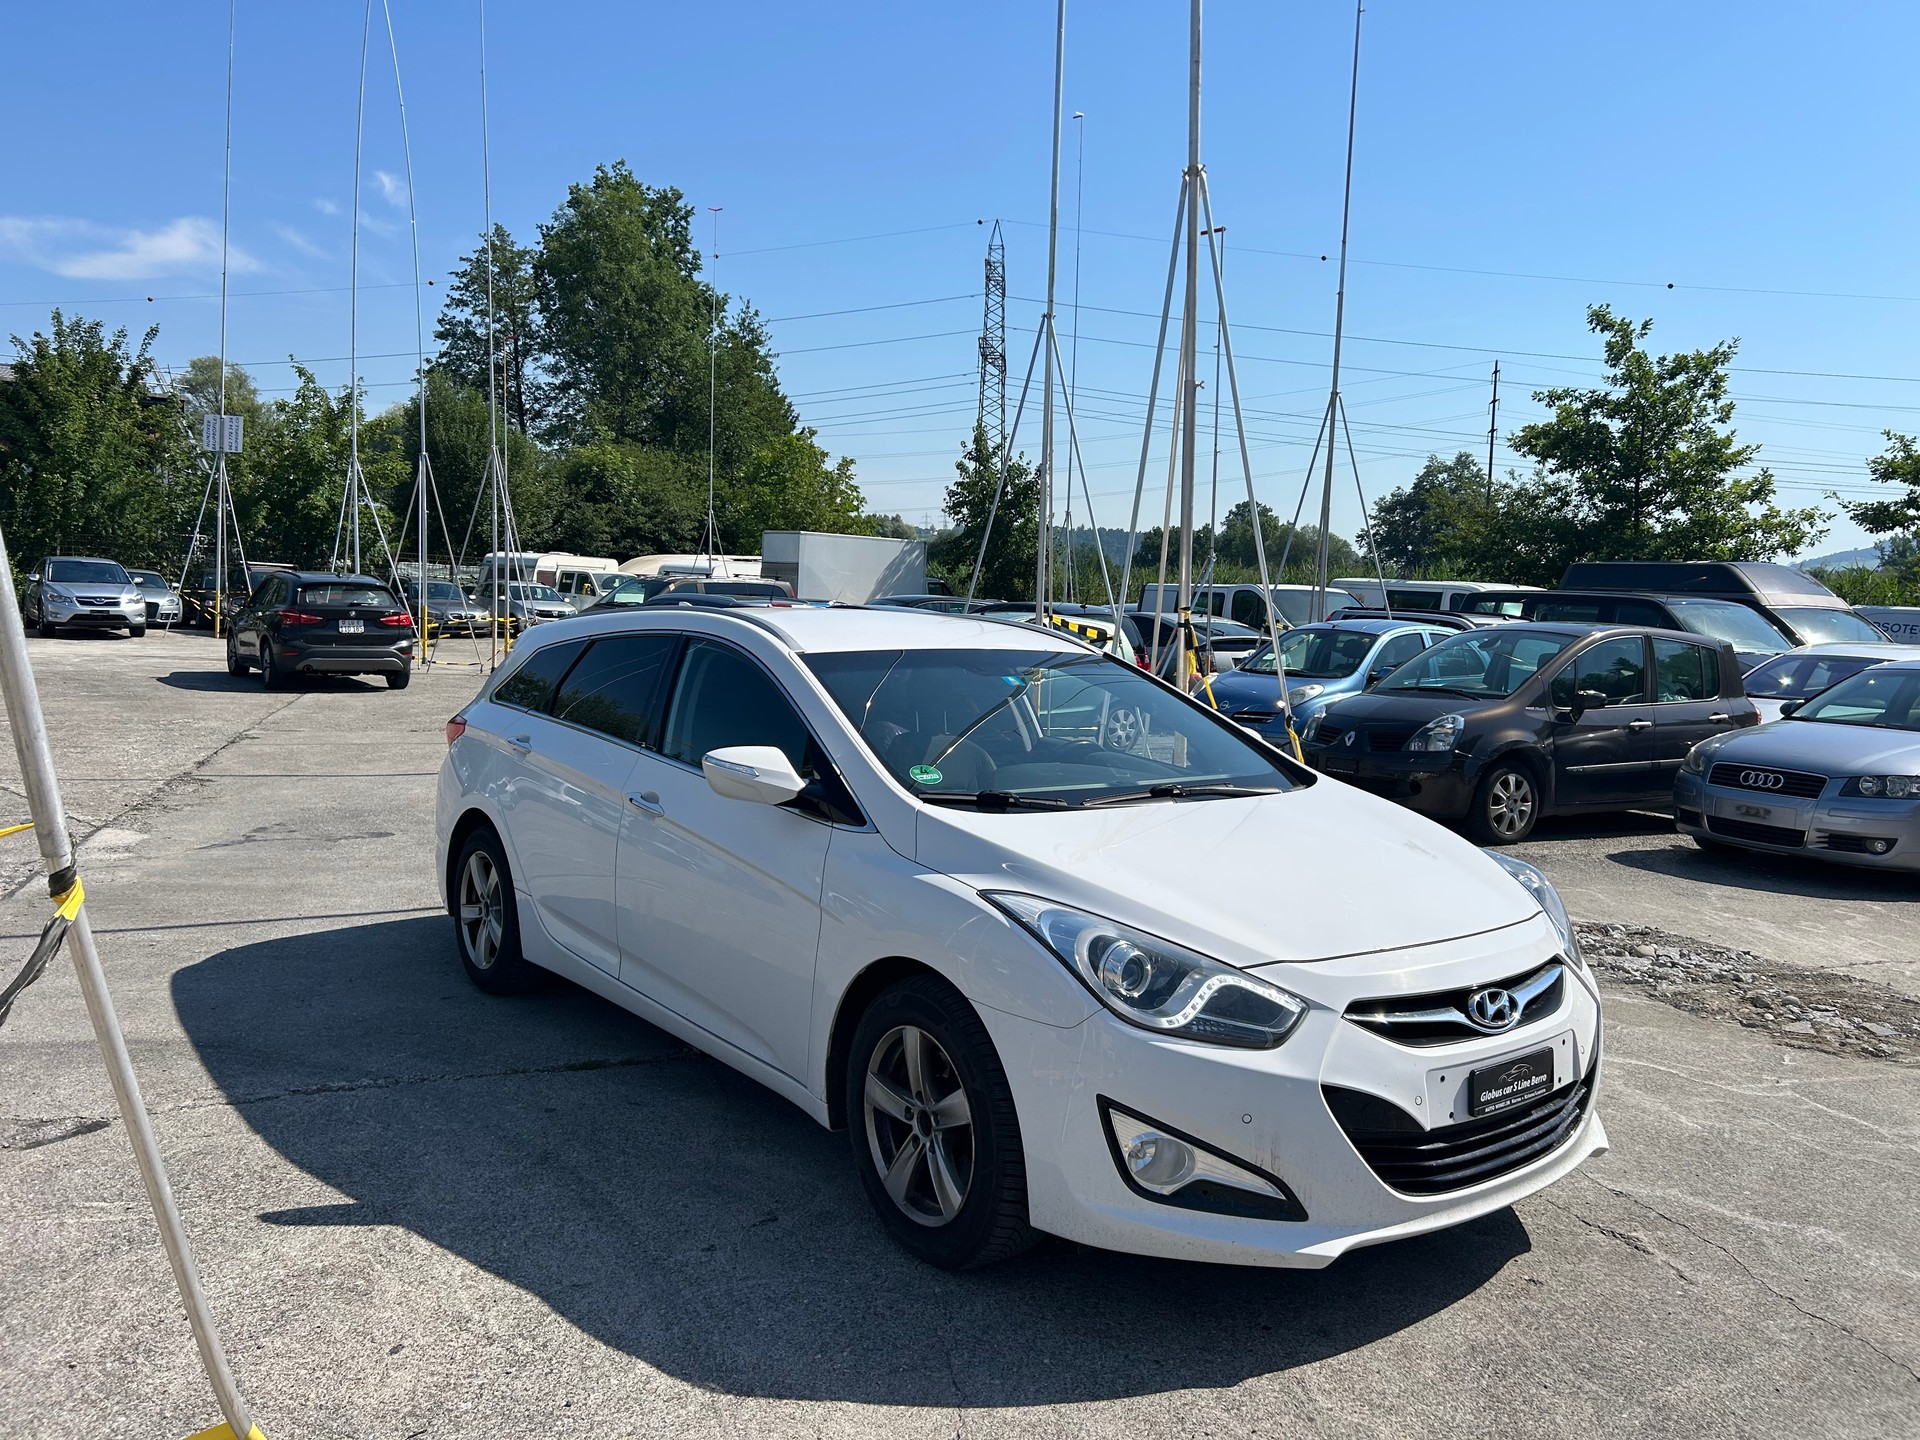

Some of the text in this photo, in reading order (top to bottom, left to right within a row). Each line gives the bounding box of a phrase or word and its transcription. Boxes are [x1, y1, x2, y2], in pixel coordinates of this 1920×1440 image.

[1480, 1074, 1547, 1102] Globus car S Line Berro
